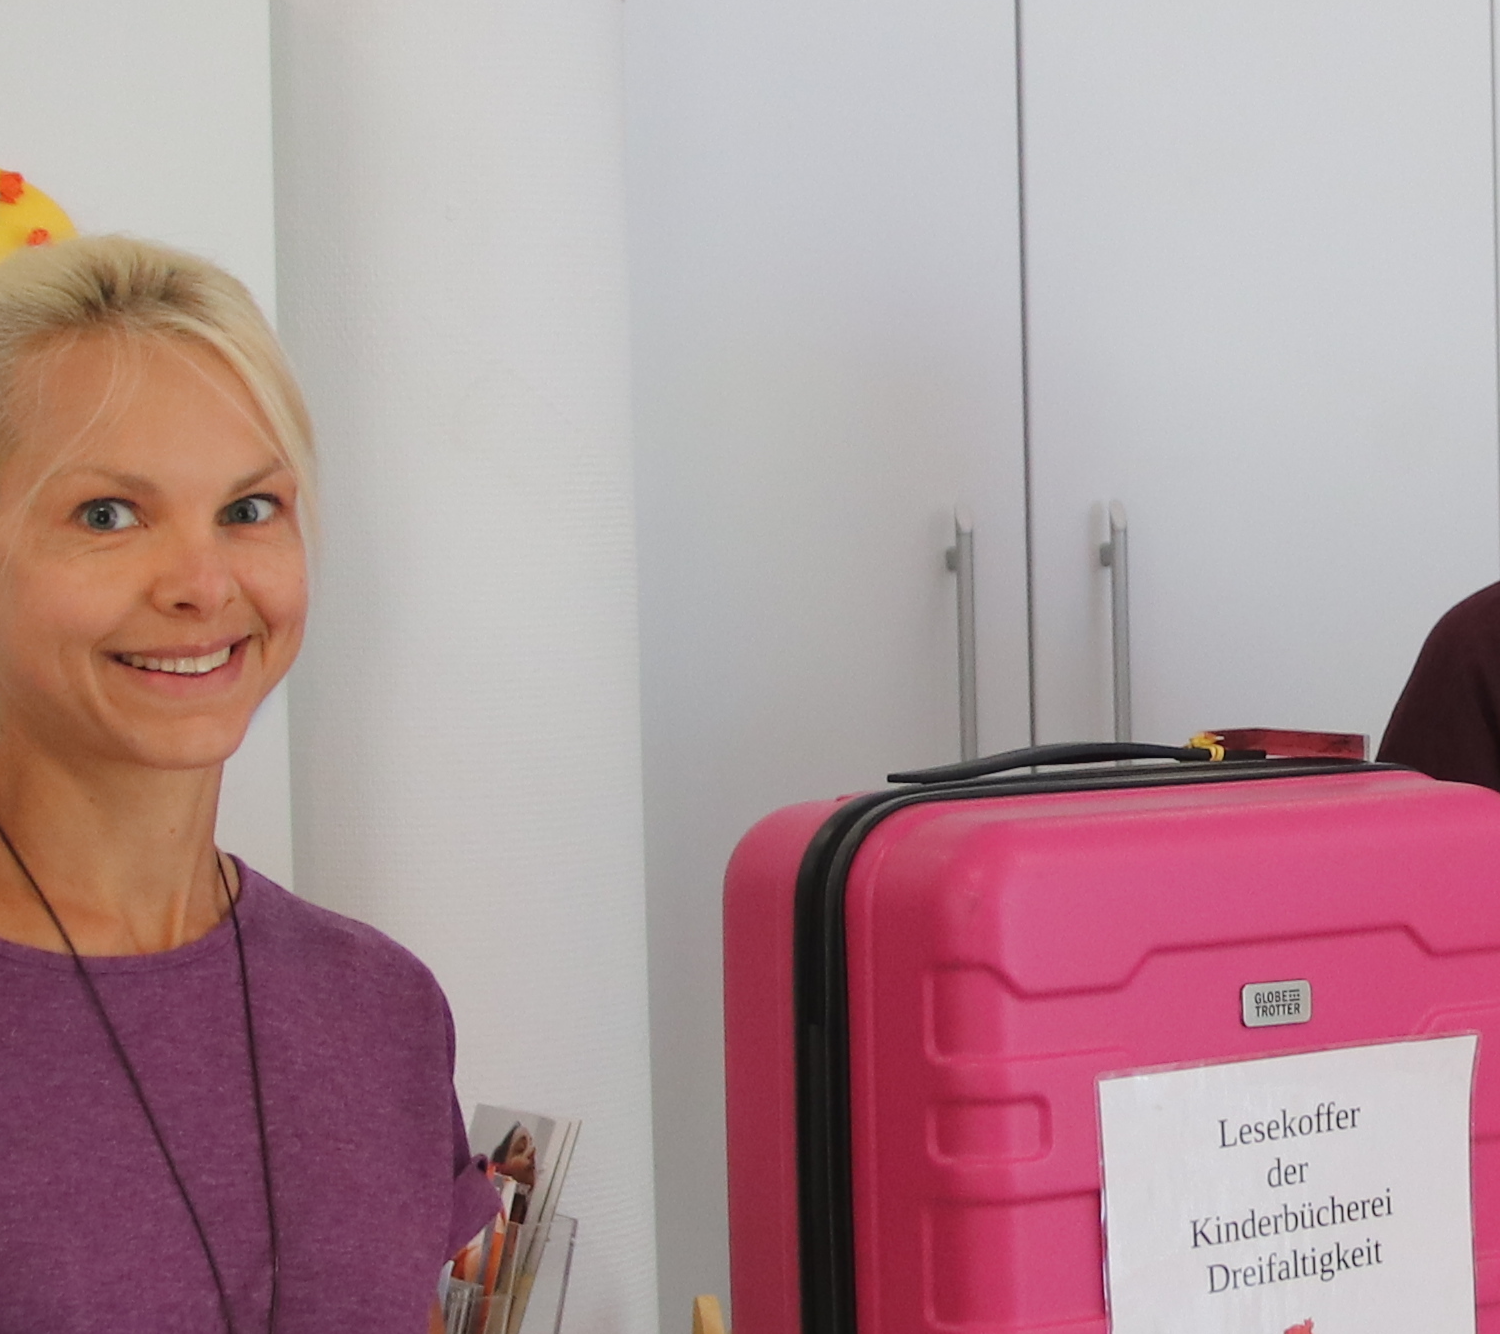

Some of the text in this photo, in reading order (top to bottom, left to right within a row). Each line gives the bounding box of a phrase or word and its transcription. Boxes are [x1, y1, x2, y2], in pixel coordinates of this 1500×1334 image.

[1254, 990, 1289, 1005] GLOBE
[1255, 1003, 1301, 1018] TROTTER
[1218, 1101, 1361, 1149] Lesekoffer
[1267, 1157, 1309, 1188] der
[1190, 1188, 1394, 1250] Kinderbücherei
[1206, 1237, 1383, 1295] Dreifaltigkeit
